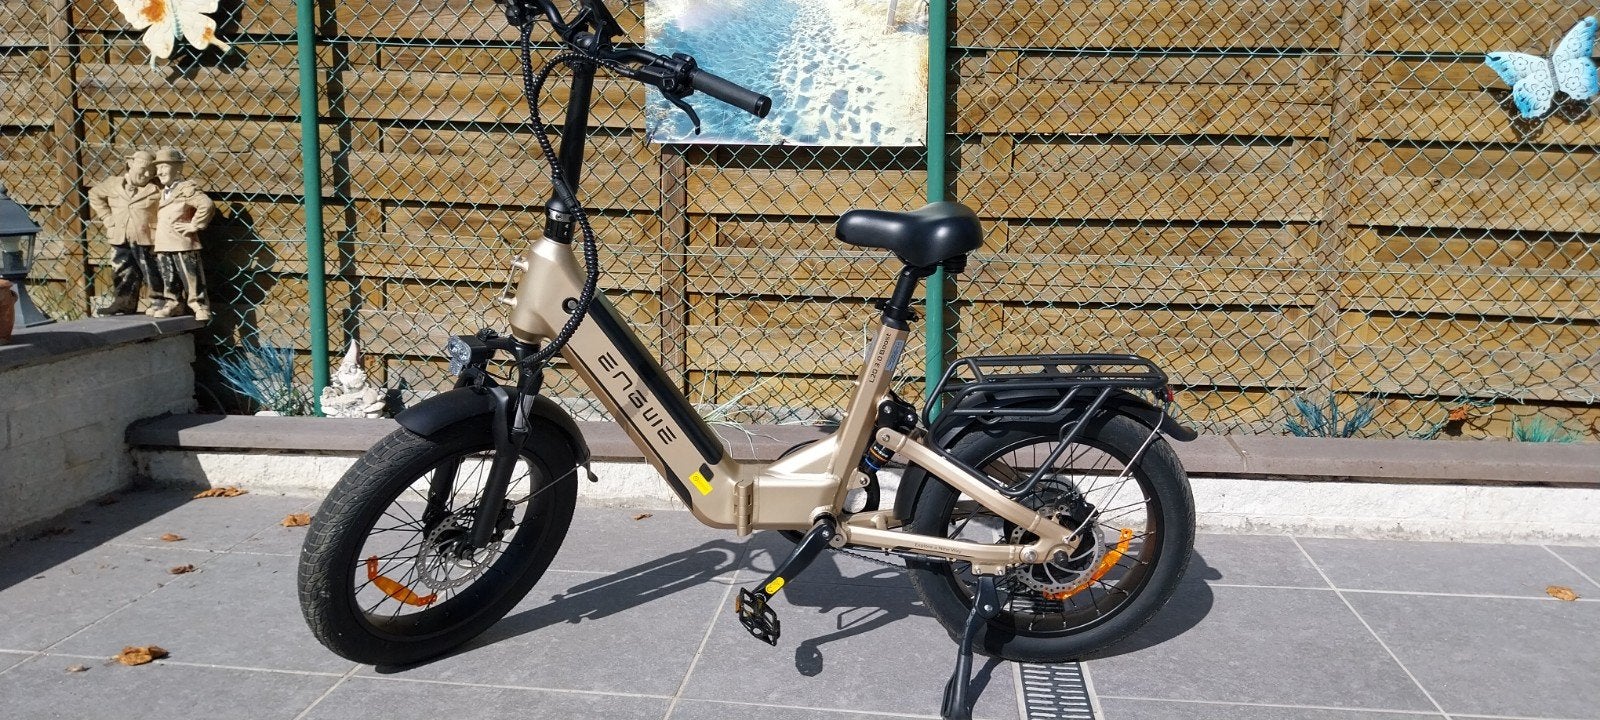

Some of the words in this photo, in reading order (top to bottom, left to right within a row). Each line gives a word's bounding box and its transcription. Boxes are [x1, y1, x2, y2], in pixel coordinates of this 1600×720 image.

[869, 369, 878, 383] L20
[875, 356, 883, 368] 3.0
[879, 333, 892, 355] Boost
